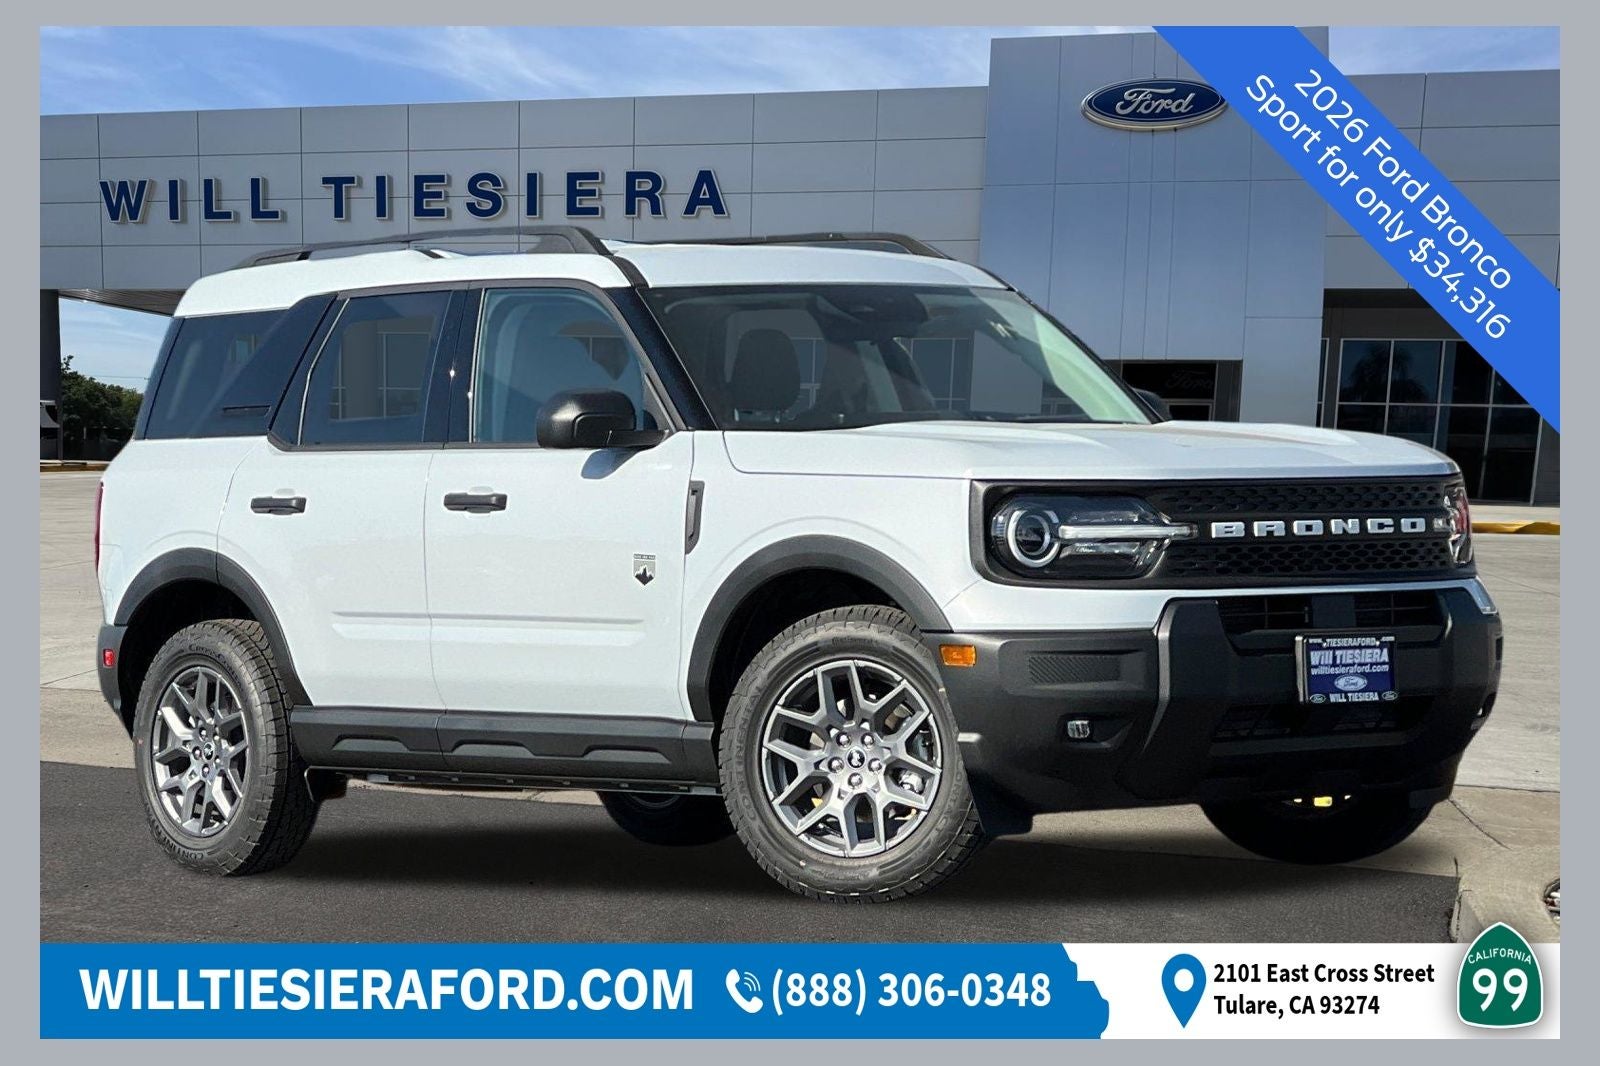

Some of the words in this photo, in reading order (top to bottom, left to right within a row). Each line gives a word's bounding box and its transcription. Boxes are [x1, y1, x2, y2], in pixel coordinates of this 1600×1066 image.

[1115, 87, 1196, 115] Ford
[99, 178, 283, 222] WILL
[321, 169, 728, 220] TIESIERA
[1211, 517, 1426, 538] BRONCO
[1335, 648, 1389, 664] TIESIERA
[1311, 664, 1389, 674] willtiesieraford.com
[1329, 693, 1347, 702] WILL
[1348, 692, 1379, 702] TIESIERA
